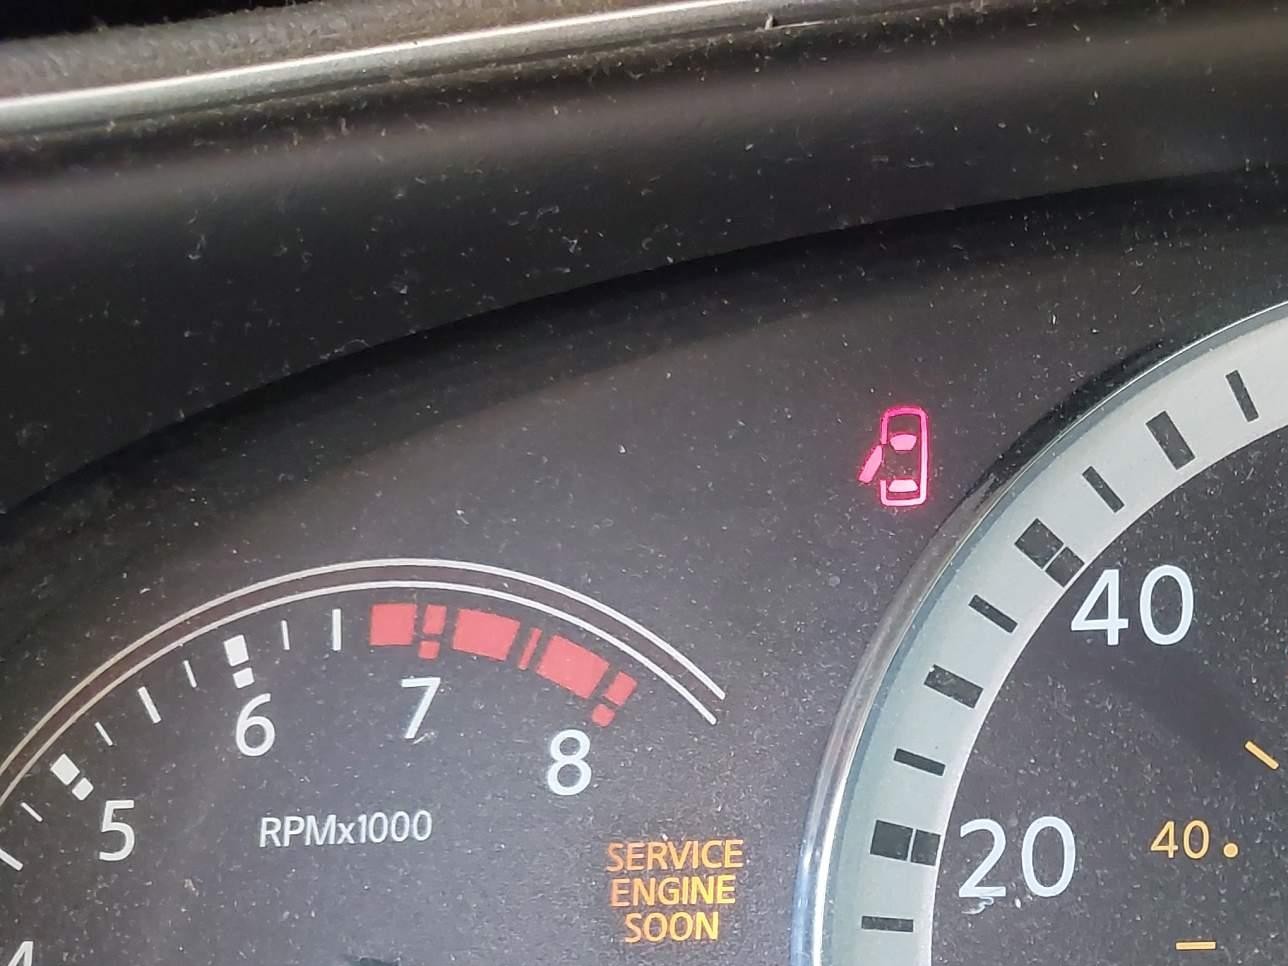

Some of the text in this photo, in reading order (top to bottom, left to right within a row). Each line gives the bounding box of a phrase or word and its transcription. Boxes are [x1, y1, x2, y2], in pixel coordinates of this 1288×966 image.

[1070, 564, 1195, 646] 40
[235, 694, 275, 757] 6
[400, 676, 441, 740] 7
[547, 730, 592, 796] 8
[98, 800, 135, 862] 5
[259, 810, 434, 849] RPMx1000
[605, 839, 745, 873] SERVICE
[957, 815, 1077, 899] 20
[1150, 820, 1210, 860] 40
[609, 874, 737, 909] ENGINE
[623, 911, 720, 945] SOON
